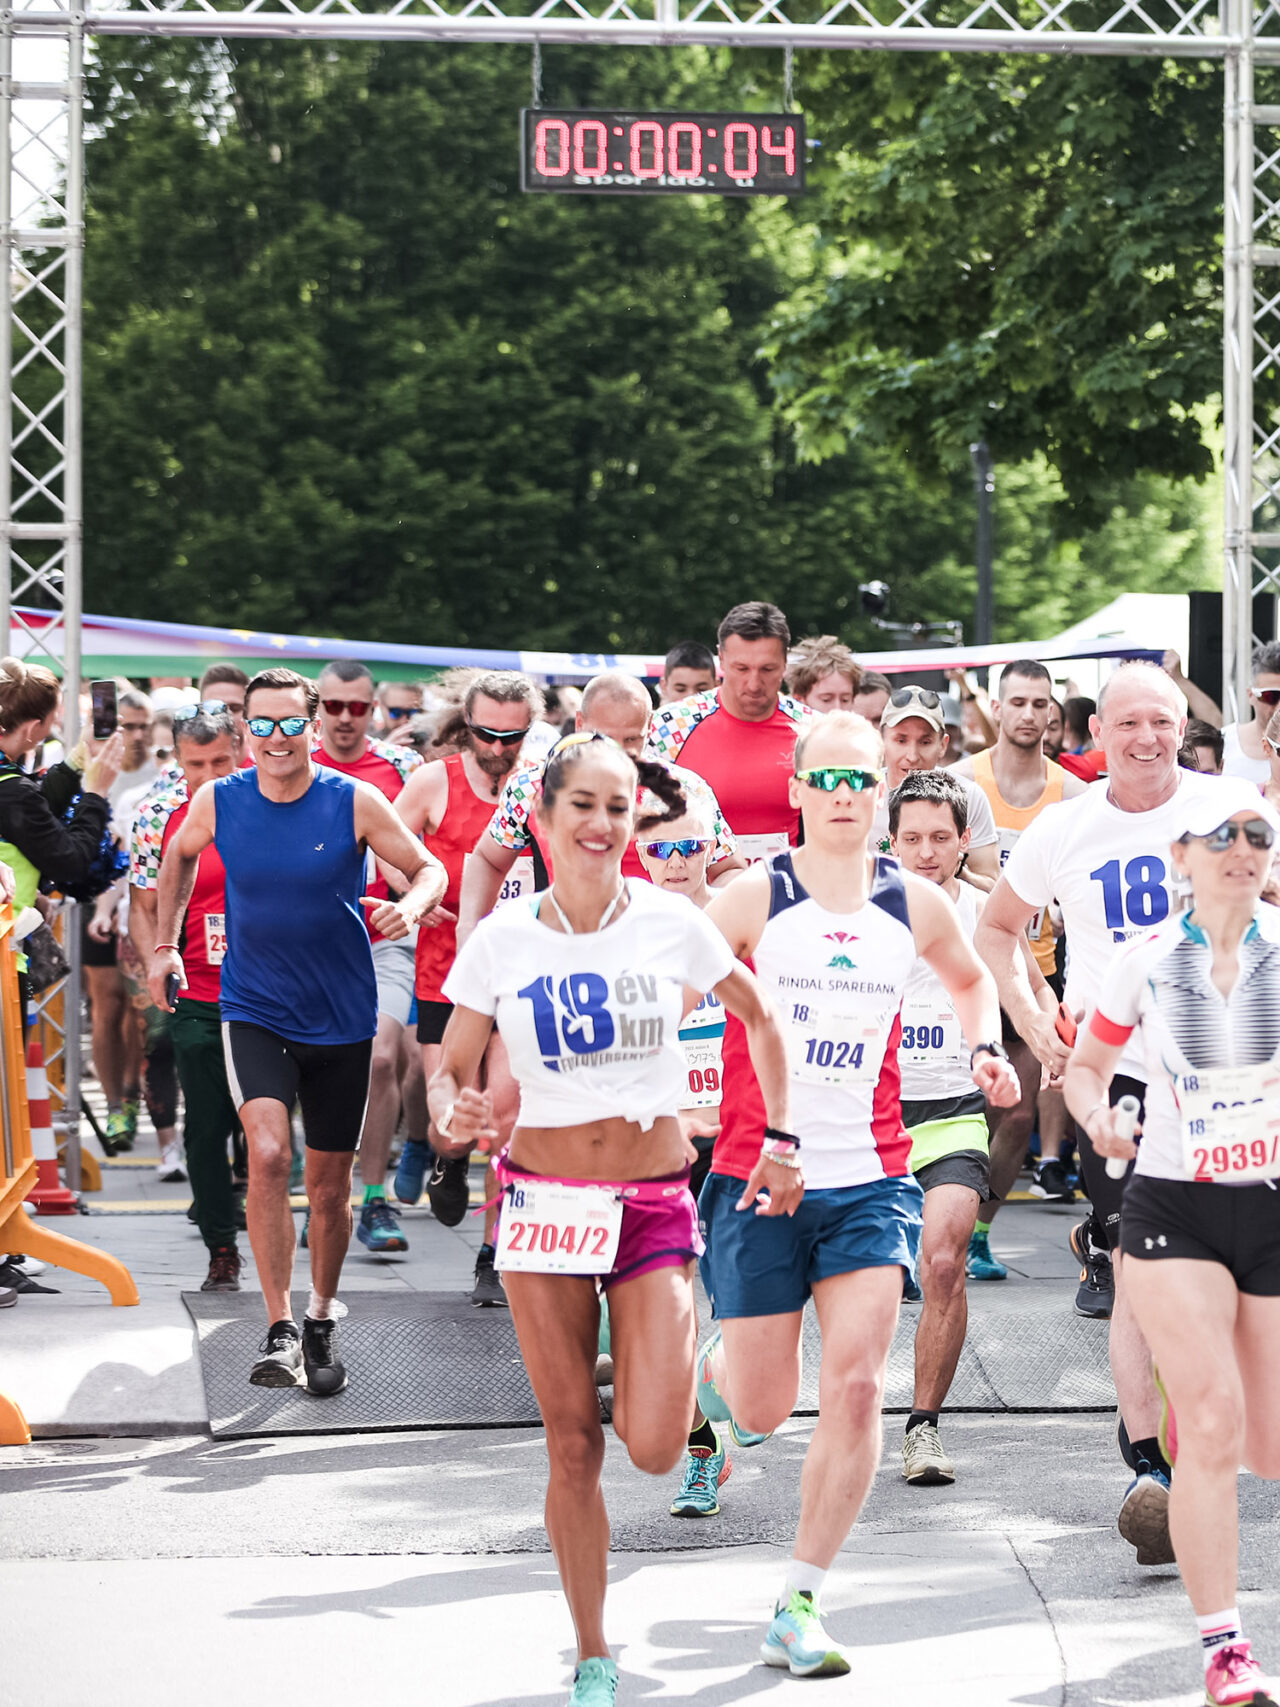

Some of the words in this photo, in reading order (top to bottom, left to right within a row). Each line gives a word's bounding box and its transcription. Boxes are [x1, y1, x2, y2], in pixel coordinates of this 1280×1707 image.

[535, 119, 796, 179] 00:00:04
[1090, 856, 1169, 928] 18
[207, 916, 220, 927] 18
[778, 976, 823, 991] RINDAL
[828, 979, 897, 995] SPAREBANK
[517, 972, 615, 1058] 18
[614, 969, 658, 1006] év
[793, 1003, 810, 1022] 18
[618, 1013, 664, 1048] km
[901, 1025, 944, 1049] 390
[805, 1038, 865, 1069] 1024
[688, 1067, 720, 1093] 09
[1183, 1075, 1200, 1091] 18
[1188, 1119, 1206, 1136] 18
[509, 1190, 525, 1209] 18
[507, 1222, 609, 1256] 2704/2
